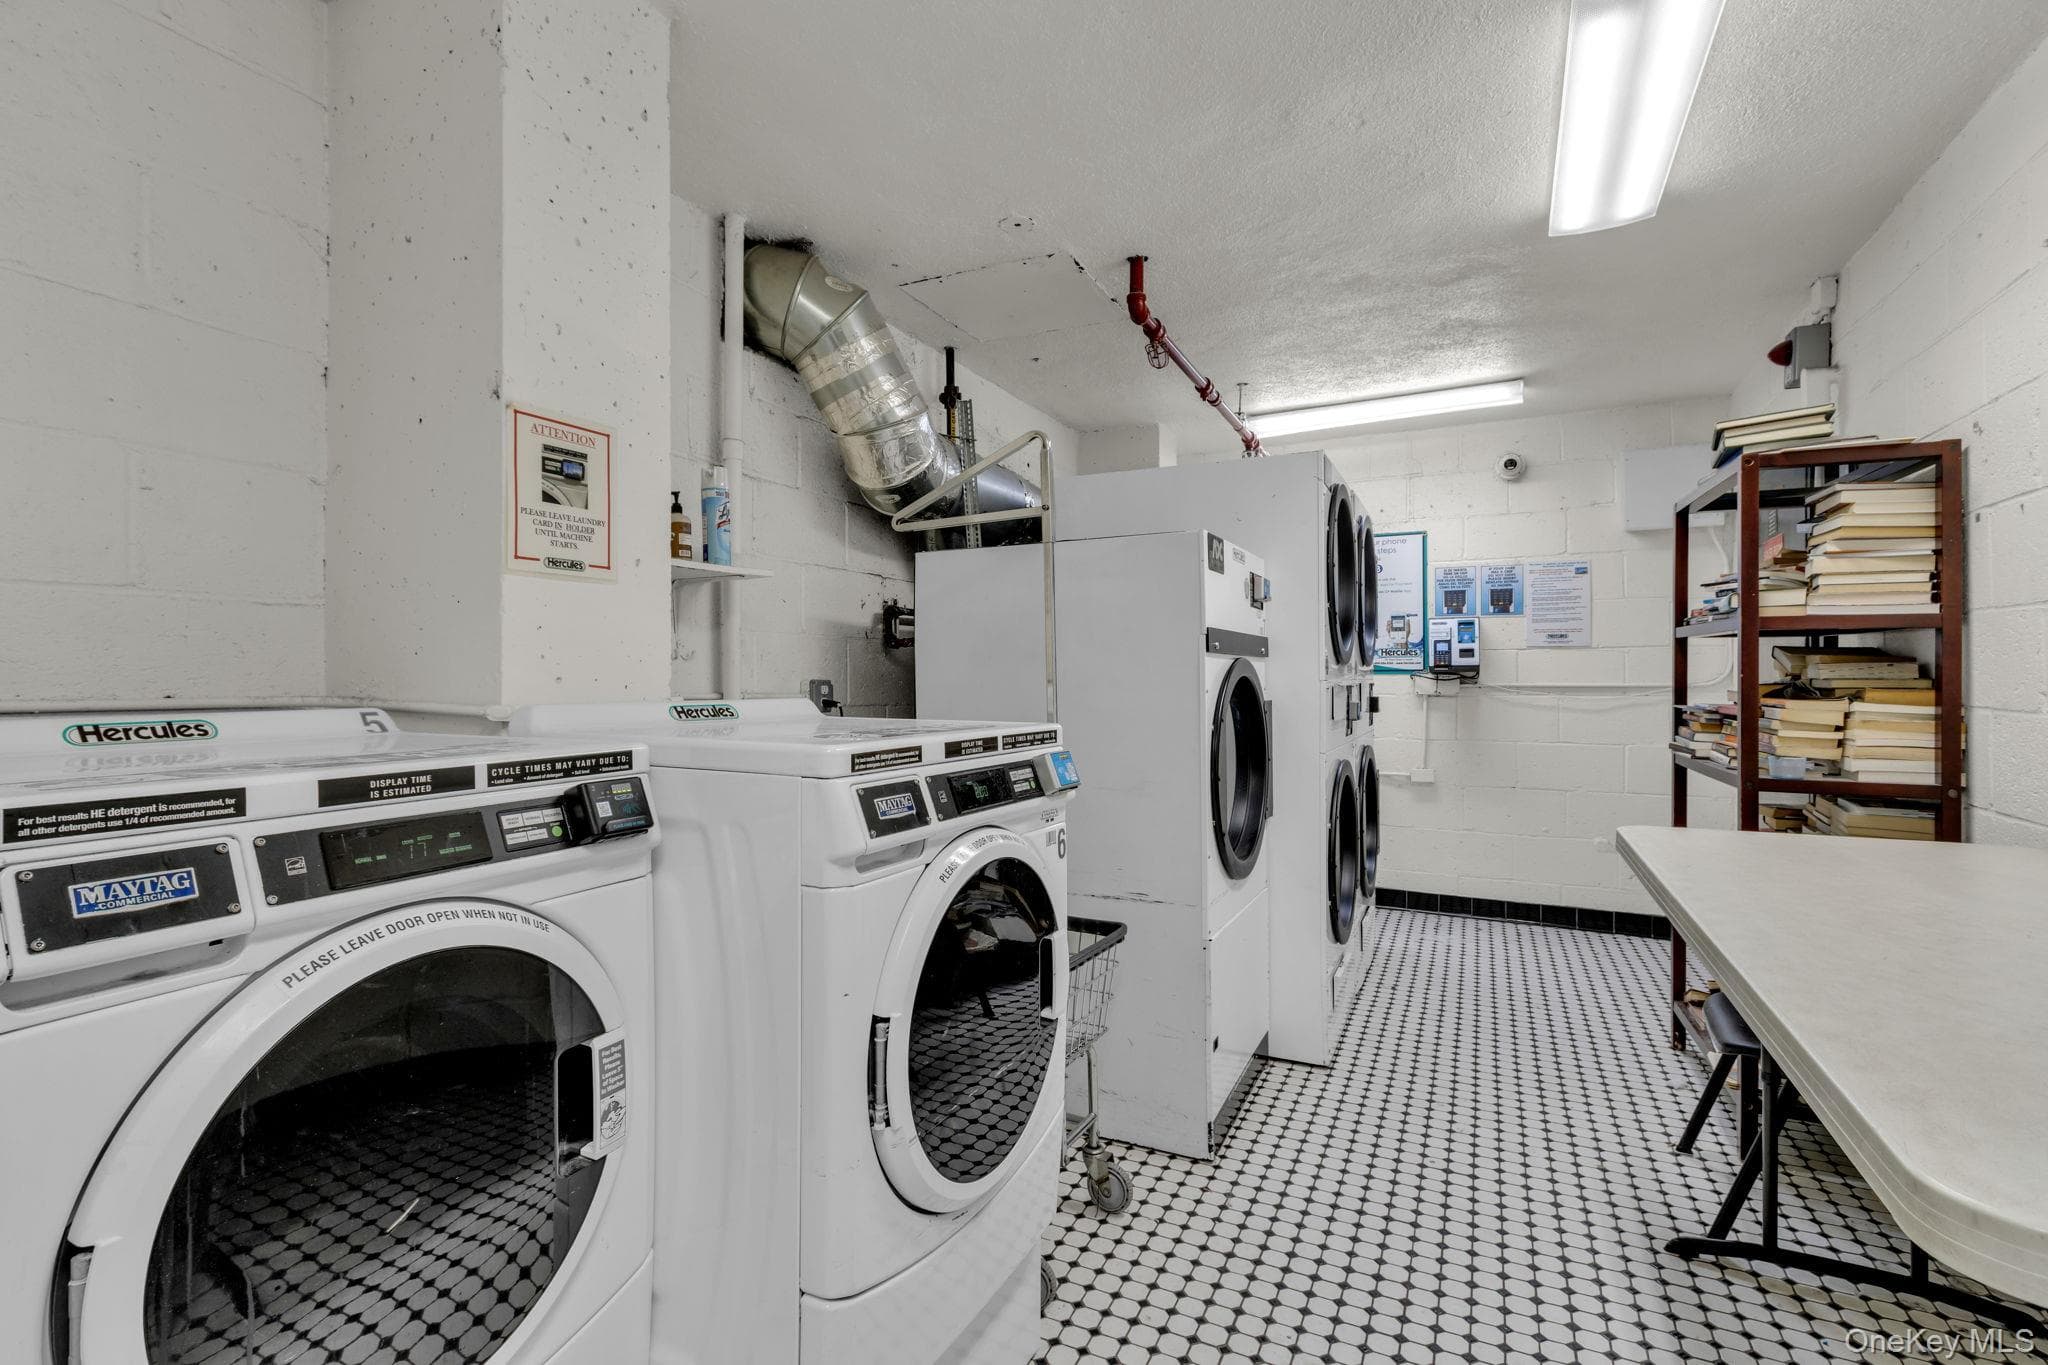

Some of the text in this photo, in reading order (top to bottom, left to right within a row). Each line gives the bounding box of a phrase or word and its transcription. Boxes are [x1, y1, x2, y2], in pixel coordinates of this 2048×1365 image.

[530, 423, 597, 447] ATTENTION
[520, 506, 606, 528] PLEASE LEAVE LAUNDRY
[532, 519, 554, 528] CARD
[566, 524, 595, 535] HOLDER
[535, 528, 594, 543] UNTIL MACHINE
[1381, 538, 1407, 546] phone
[547, 557, 583, 570] Hercules
[1381, 648, 1418, 656] Hercules
[674, 705, 735, 719] Hercules
[359, 711, 389, 733] 5
[77, 721, 210, 743] Hercules
[491, 755, 629, 777] CYCLE TIMES MAY VARY DUE TO:
[370, 775, 432, 788] DISPLAY TIME
[370, 785, 432, 799] IS ESTIMATED
[18, 818, 34, 826] For
[36, 815, 57, 824] best
[57, 812, 89, 822] results
[90, 808, 106, 819] HE
[108, 804, 157, 817] detergent
[158, 803, 168, 812] is
[169, 799, 225, 811] recommended,
[877, 796, 912, 811] MAYTAG
[18, 828, 30, 837] all
[32, 826, 57, 835] other
[58, 820, 106, 832] detergents
[125, 817, 138, 825] 1/4
[140, 816, 148, 824] of
[150, 810, 205, 822] recommended
[206, 807, 236, 816] amount.
[1058, 828, 1066, 859] 6
[77, 873, 190, 905] MAYTAG
[99, 892, 174, 909] COMMERCIAL
[281, 909, 550, 989] PLEASE LEAVE DOOR OPEN WHEN NOT IN USE
